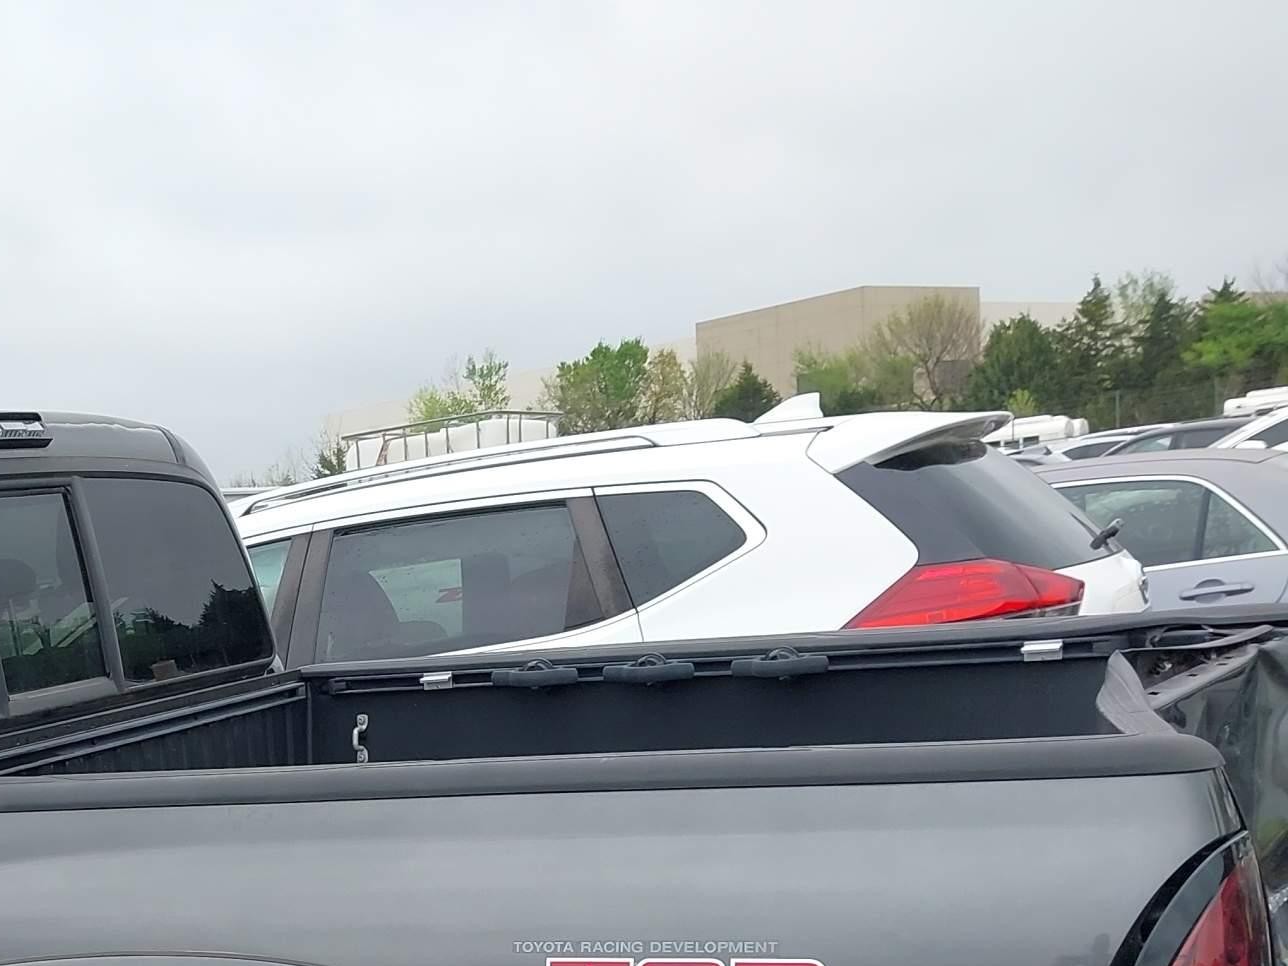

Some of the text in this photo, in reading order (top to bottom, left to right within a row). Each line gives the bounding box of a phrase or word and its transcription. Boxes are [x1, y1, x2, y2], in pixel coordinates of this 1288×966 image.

[513, 941, 779, 954] TOYOTA RACING DEVELOPMENT
